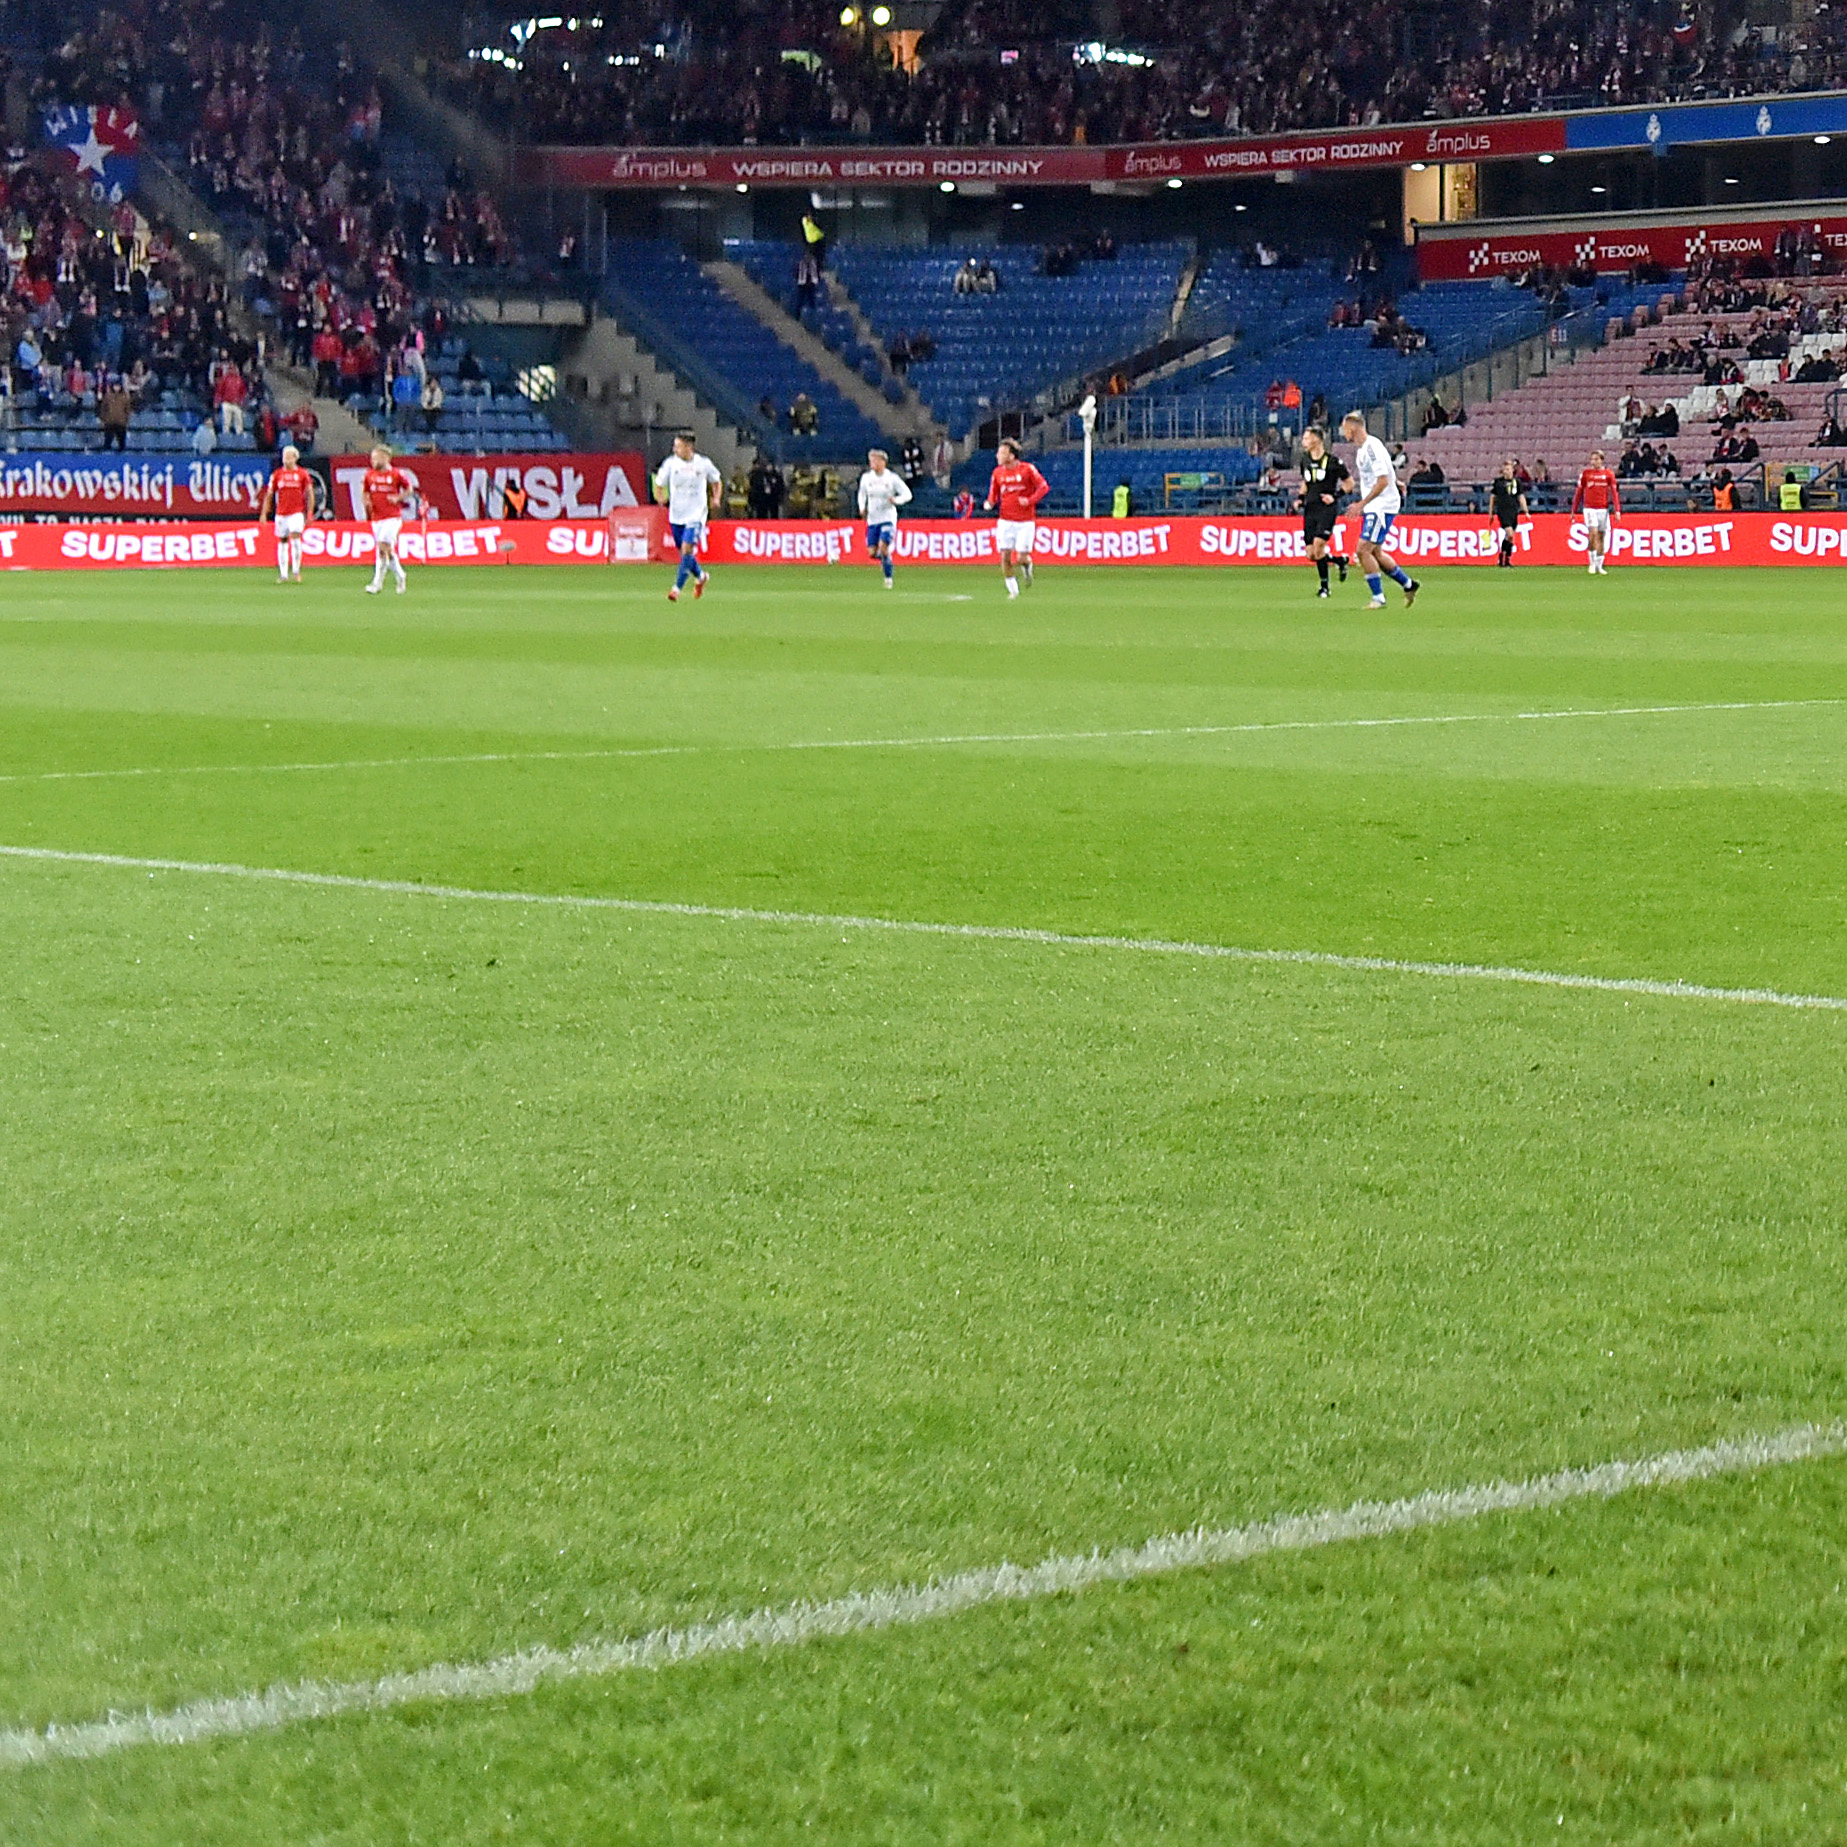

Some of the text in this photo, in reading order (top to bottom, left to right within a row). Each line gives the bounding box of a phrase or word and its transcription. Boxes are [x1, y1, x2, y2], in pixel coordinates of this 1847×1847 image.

[1204, 151, 1268, 169] WSPIERA
[1271, 147, 1327, 164] SEKTOR
[1331, 141, 1404, 160] RODZINNY
[732, 160, 833, 177] WSPIERA
[841, 159, 924, 177] SEKTOR
[932, 160, 1043, 177] RODZINNY
[1493, 250, 1542, 264] TEXOM
[1599, 244, 1650, 259] TEXOM
[1710, 238, 1763, 253] TEXOM
[61, 528, 260, 562] SUPERBET
[734, 527, 854, 559] SUPERBET
[1034, 525, 1171, 559] SUPERBET
